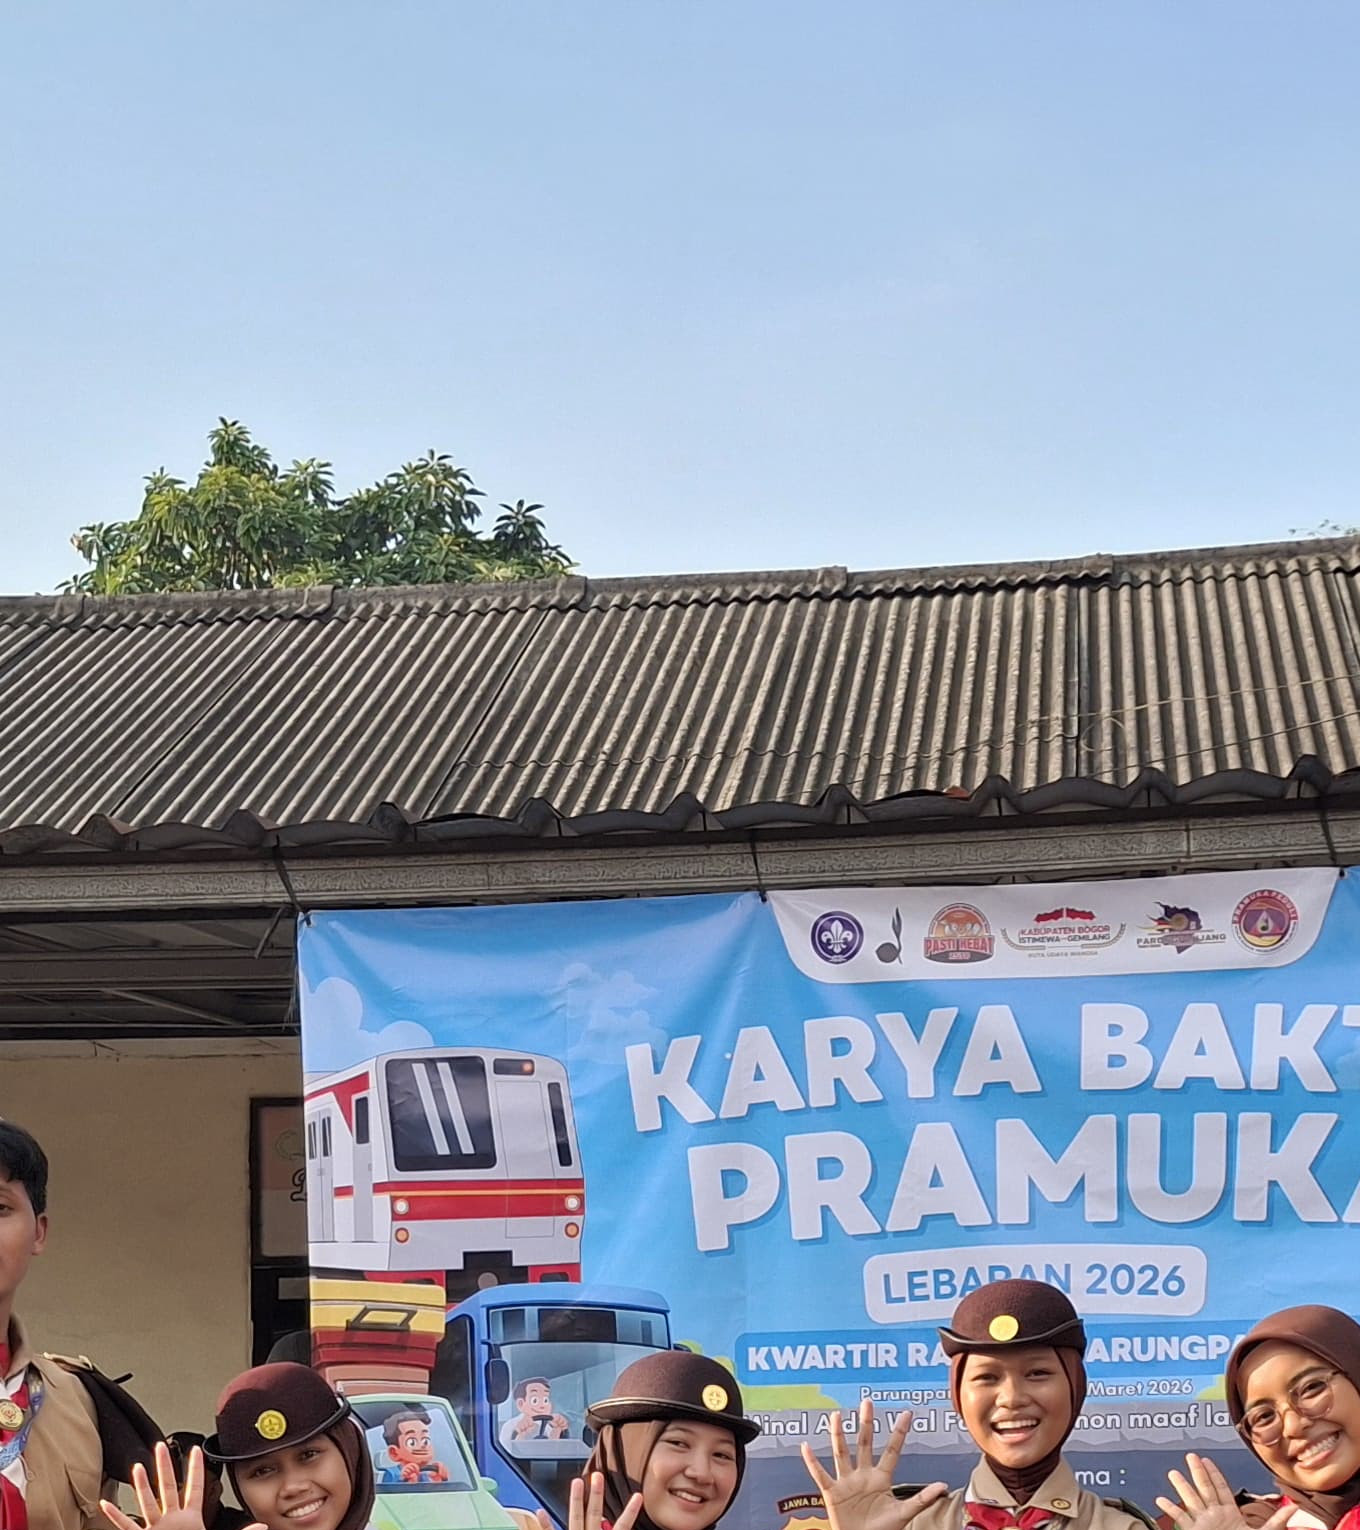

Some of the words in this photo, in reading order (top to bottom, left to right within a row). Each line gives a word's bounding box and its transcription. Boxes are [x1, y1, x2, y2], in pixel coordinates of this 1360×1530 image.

[1020, 926, 1076, 936] KABUPATEN
[1077, 924, 1111, 934] BOGOR
[625, 1005, 1042, 1132] KARYA
[1087, 1262, 1187, 1297] 2026
[748, 1341, 898, 1372] KWARTIR
[1086, 1381, 1143, 1397] Maret
[1147, 1380, 1193, 1396] 2026
[1128, 1402, 1199, 1429] maaf
[783, 1497, 810, 1511] JAWA
